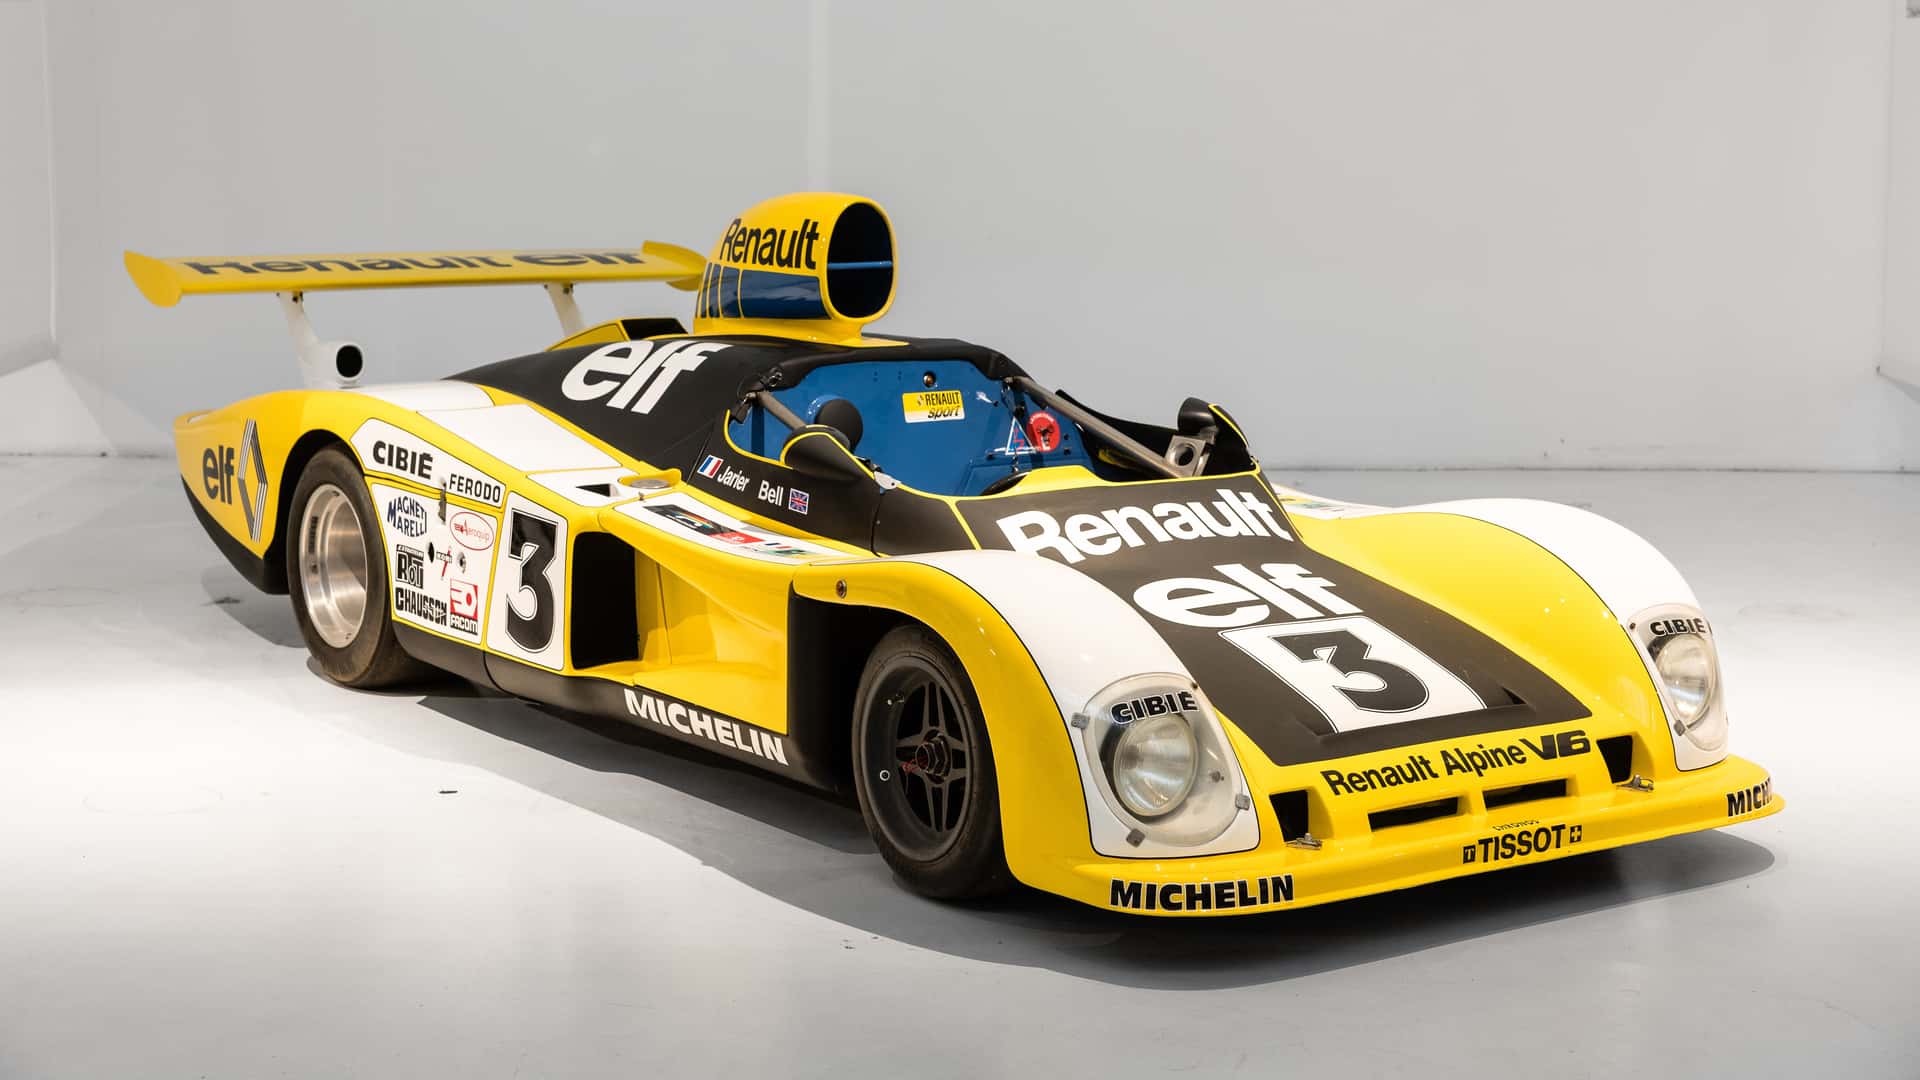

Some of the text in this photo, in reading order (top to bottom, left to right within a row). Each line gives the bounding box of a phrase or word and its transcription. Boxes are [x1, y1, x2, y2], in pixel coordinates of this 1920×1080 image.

[719, 217, 819, 271] Renault
[561, 339, 735, 415] elf
[925, 391, 960, 407] RENAULT
[928, 405, 960, 420] sport
[202, 444, 235, 506] elf
[449, 472, 501, 504] FERODO
[717, 465, 750, 492] Jarier
[758, 480, 784, 507] Bell
[996, 488, 1294, 565] Renault
[506, 508, 559, 653] 3
[1133, 562, 1364, 628] elf
[395, 586, 448, 627] CHAUSSON
[450, 614, 478, 635] FACOM
[1269, 629, 1431, 714] 3
[623, 688, 790, 767] MICHELIN
[1319, 729, 1592, 796] Renault Alpine V6
[1726, 776, 1772, 818] MICH
[1478, 823, 1566, 863] TISSOT
[1109, 873, 1295, 912] MICHELIN
